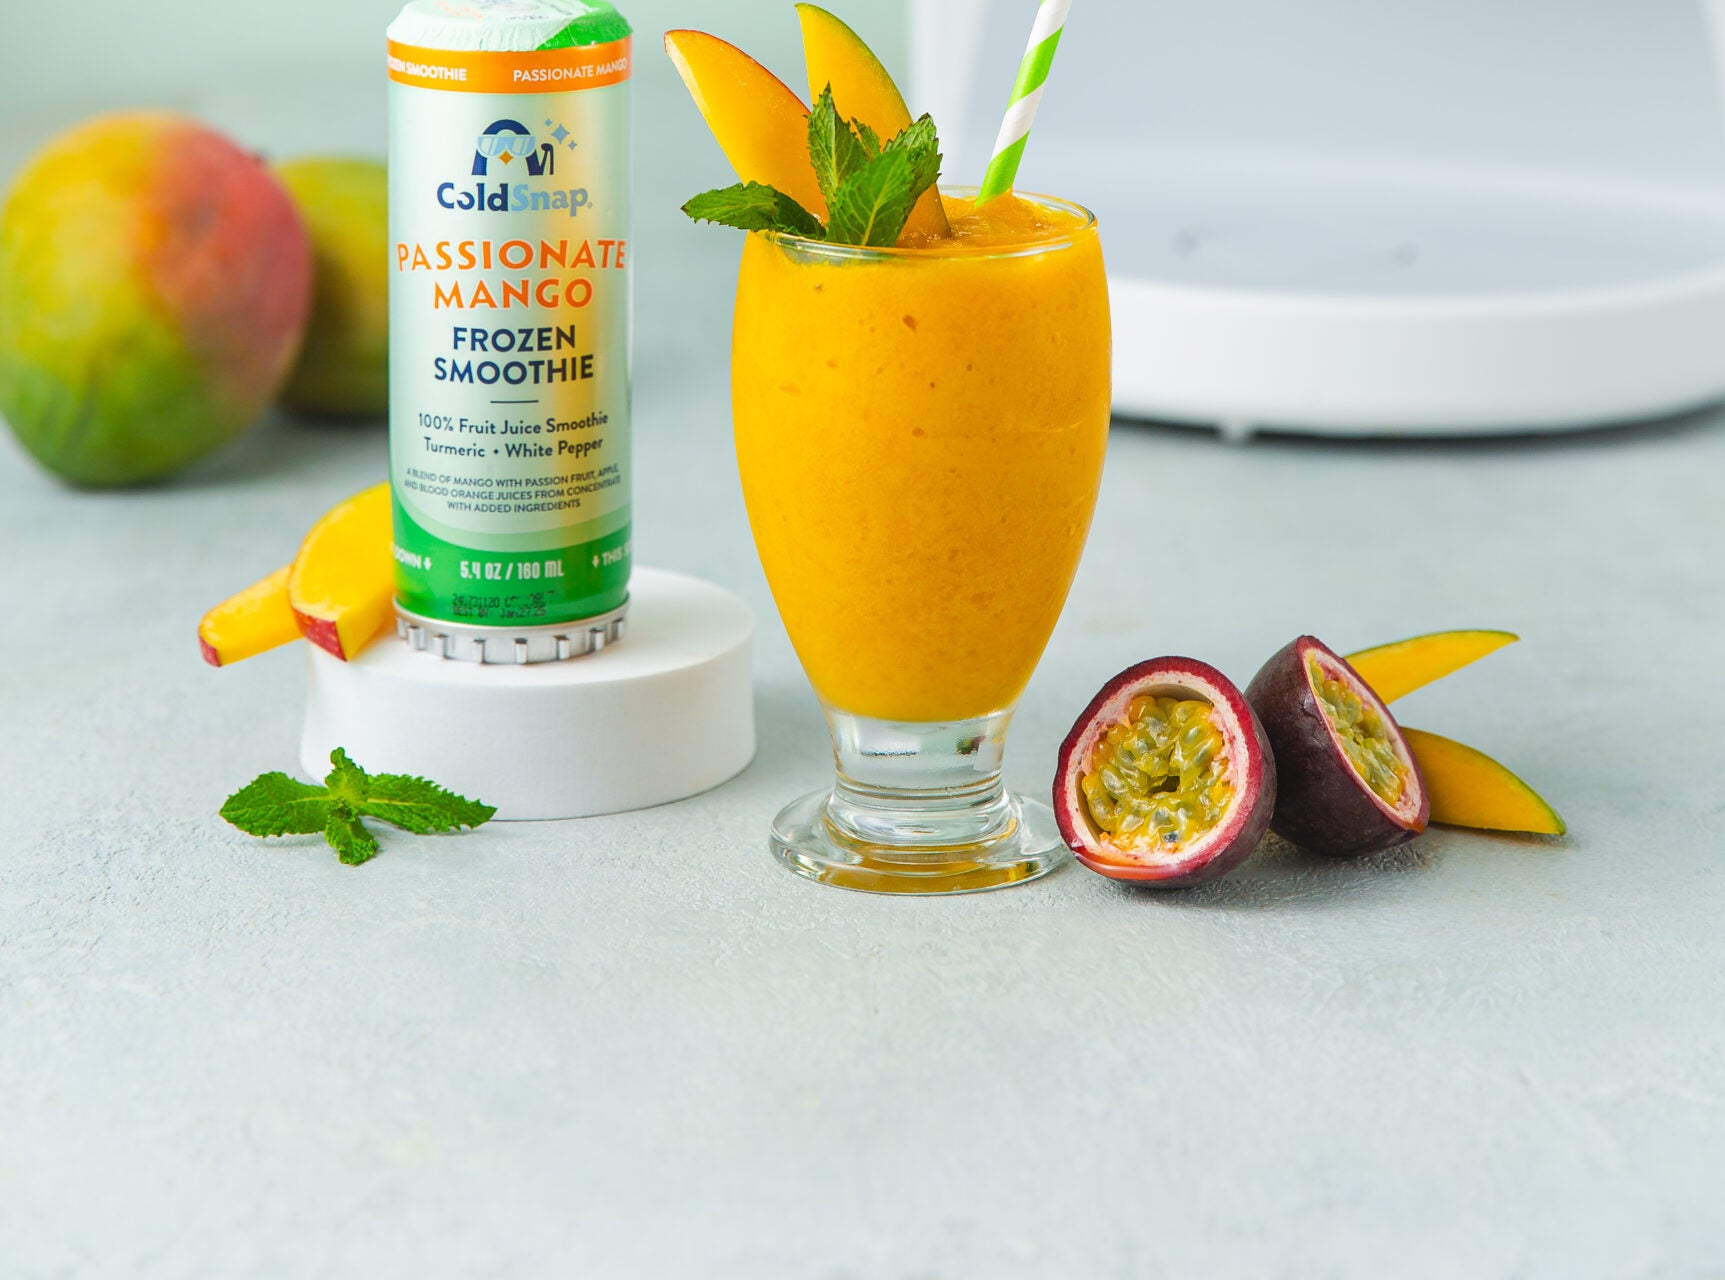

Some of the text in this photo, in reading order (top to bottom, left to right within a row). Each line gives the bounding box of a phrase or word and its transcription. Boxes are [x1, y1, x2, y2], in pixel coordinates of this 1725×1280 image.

[406, 61, 468, 81] SMOOTHIE
[513, 57, 628, 82] PASSIONATE MANGO
[396, 239, 627, 272] PASSIONATE
[433, 278, 593, 309] MANGO
[453, 324, 576, 352] FROZEN
[434, 353, 594, 385] SMOOTHIE
[418, 411, 609, 435] 100% Fruit Juice Smoothie
[424, 436, 603, 459] Turmeric White Pepper
[412, 468, 437, 481] BLEND
[438, 475, 452, 484] OF
[453, 477, 494, 488] MANGO
[496, 479, 522, 488] WITH
[525, 475, 568, 488] PASSION
[419, 483, 449, 497] BLOOD
[450, 489, 494, 500] ORANGE
[495, 491, 532, 501] JUICES
[534, 489, 564, 499] FROM
[447, 498, 581, 513] WITH ADDED INGREDIENTS
[460, 560, 481, 579] 5.4
[485, 562, 502, 580] OZ
